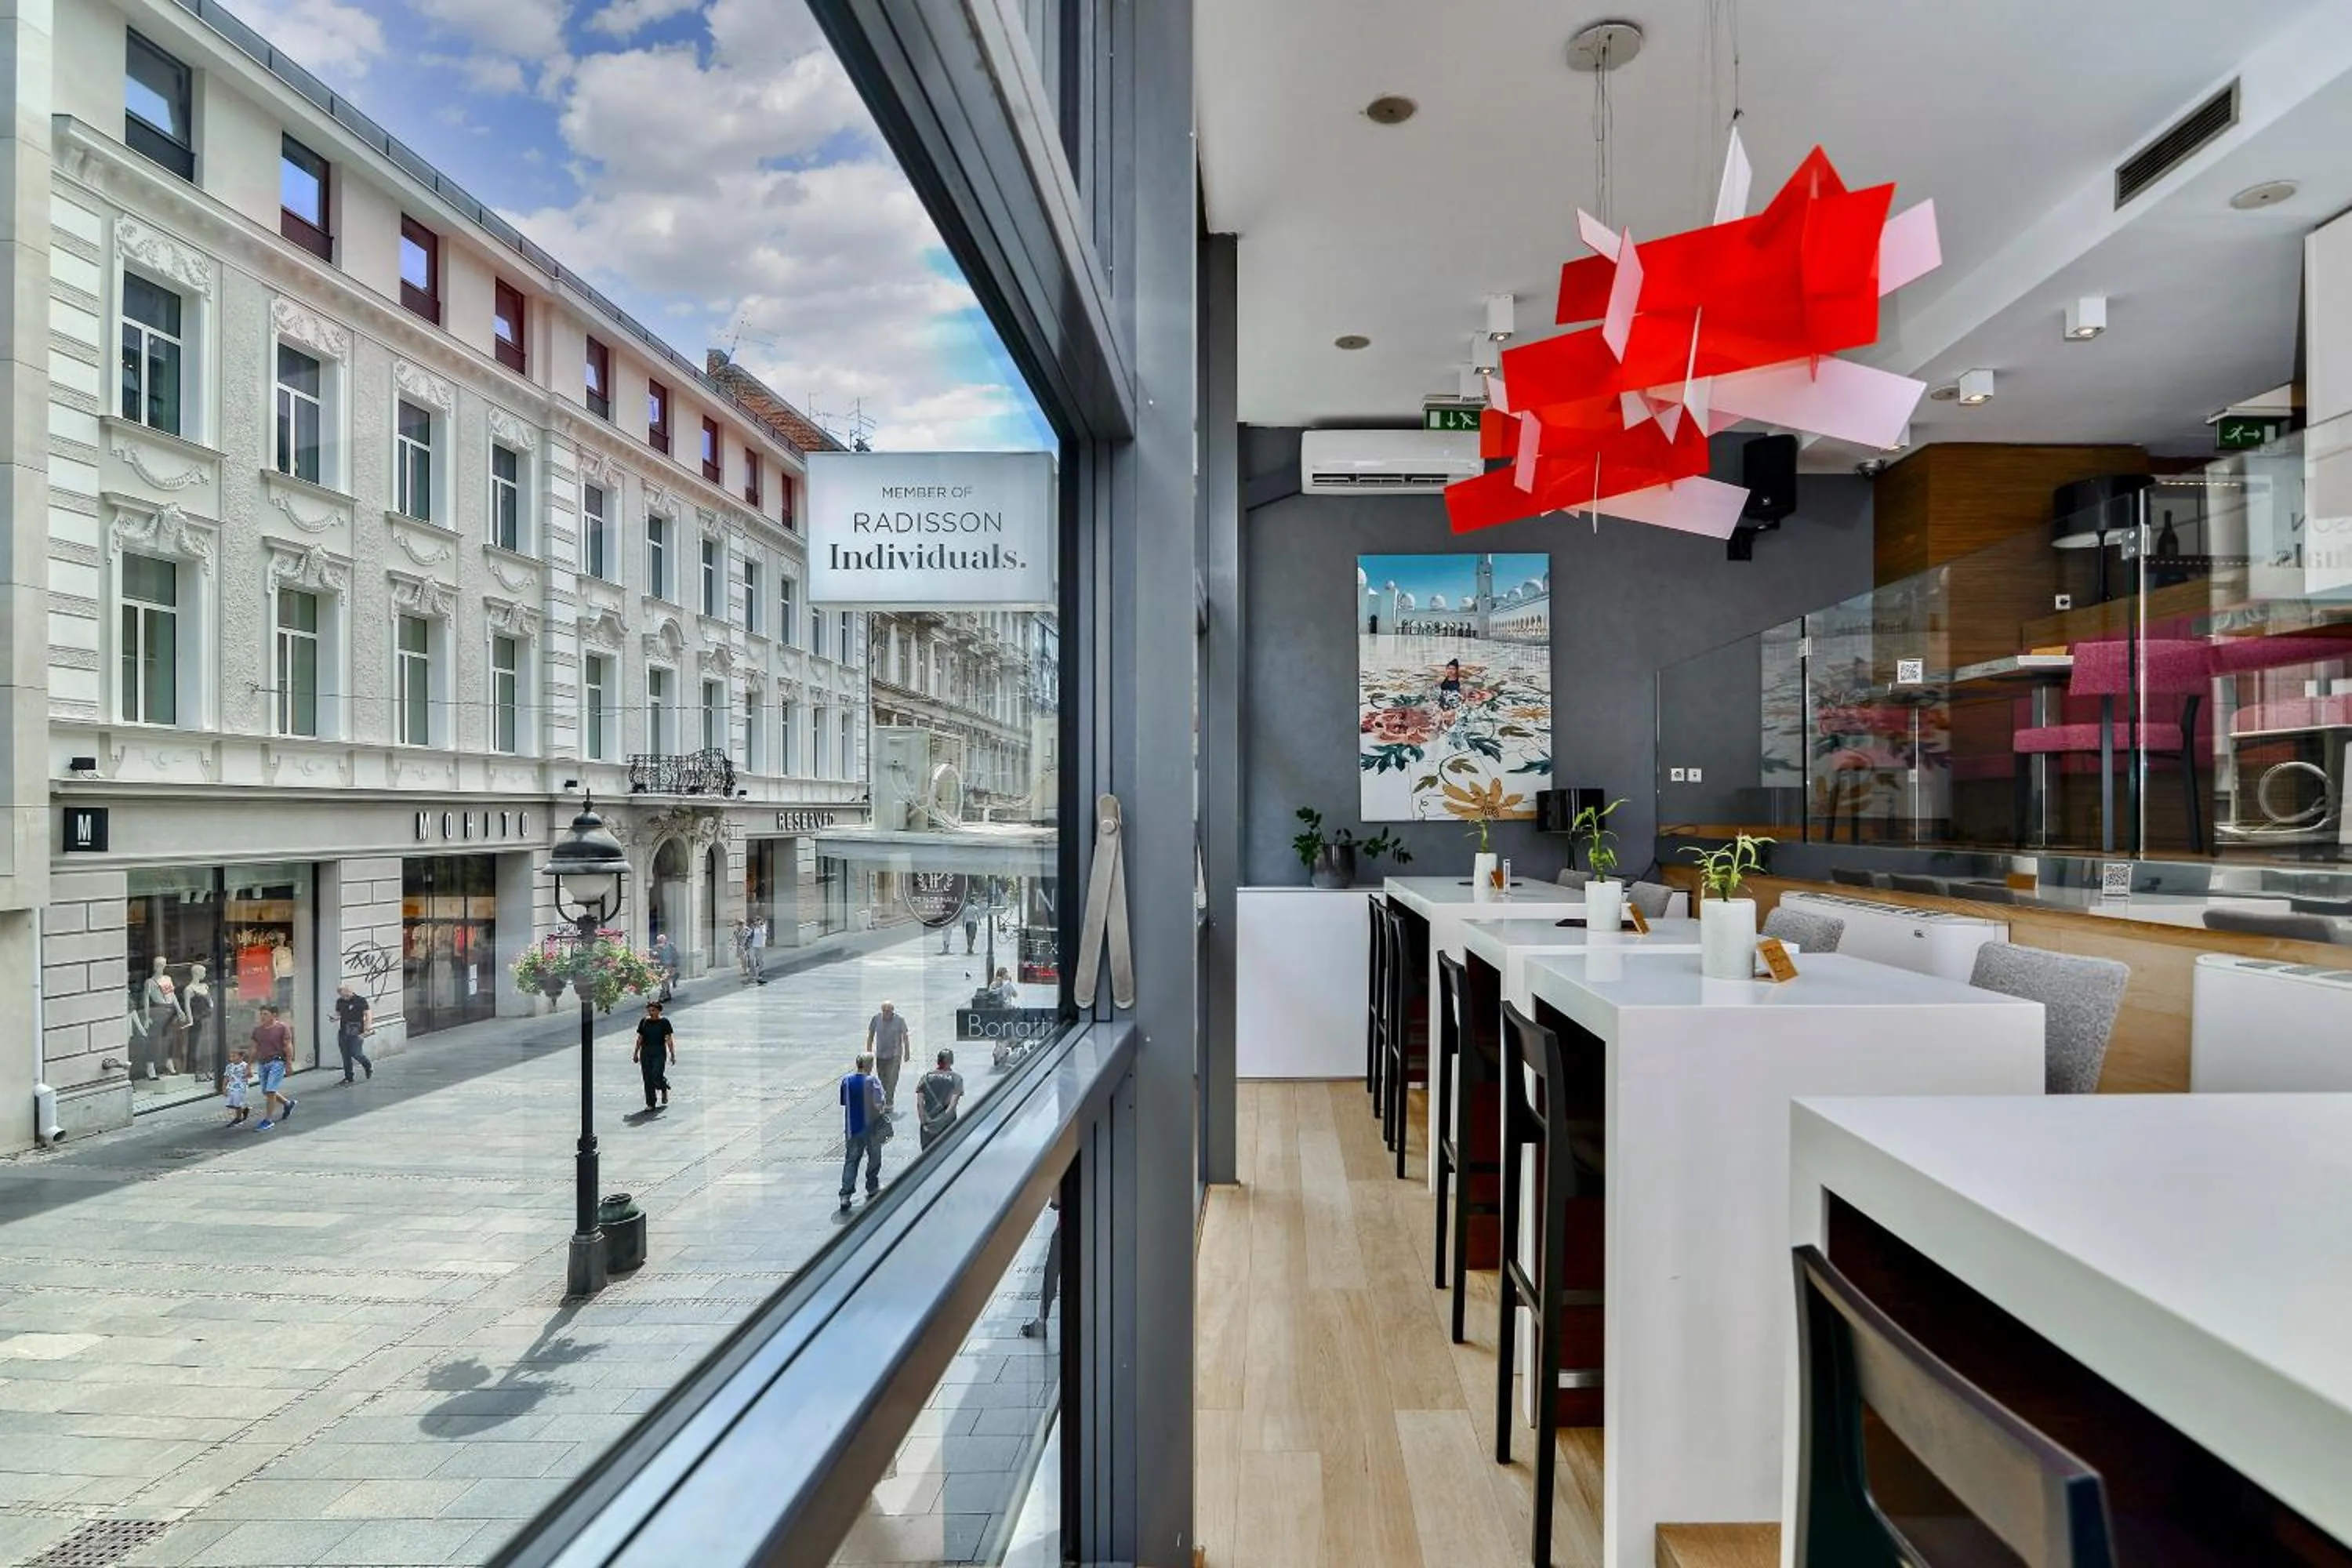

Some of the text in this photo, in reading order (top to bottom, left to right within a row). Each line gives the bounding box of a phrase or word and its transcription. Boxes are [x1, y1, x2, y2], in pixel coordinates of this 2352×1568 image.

[882, 486, 973, 499] MEMBER OF
[853, 512, 1003, 534] RADISSON
[828, 543, 1027, 571] Individuals.
[77, 814, 93, 841] M
[416, 811, 529, 840] MOHITO
[776, 811, 835, 830] RESERVED
[967, 1013, 1054, 1037] Bonatti
